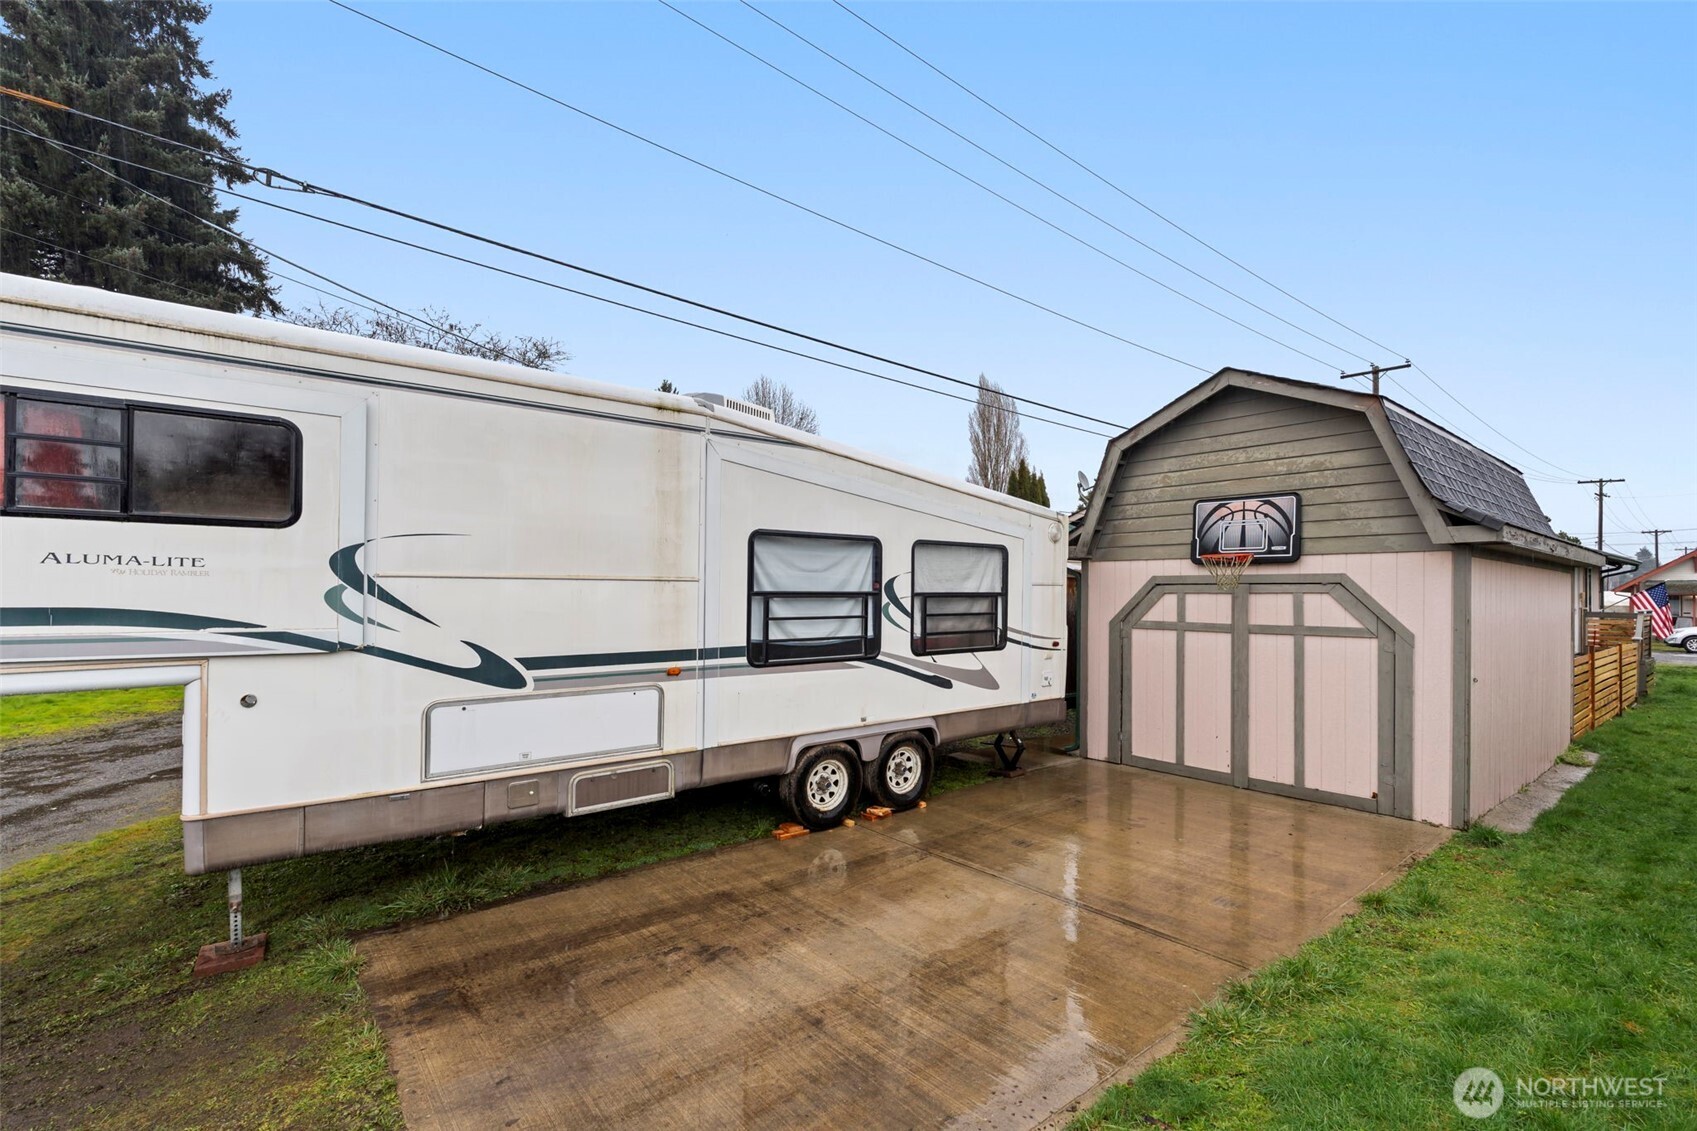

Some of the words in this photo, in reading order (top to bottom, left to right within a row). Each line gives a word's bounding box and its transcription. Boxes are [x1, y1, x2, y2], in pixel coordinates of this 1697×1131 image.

[40, 552, 206, 568] ALUMA-LITE
[129, 568, 167, 577] HOLIDAY
[171, 569, 211, 577] RAMBLER
